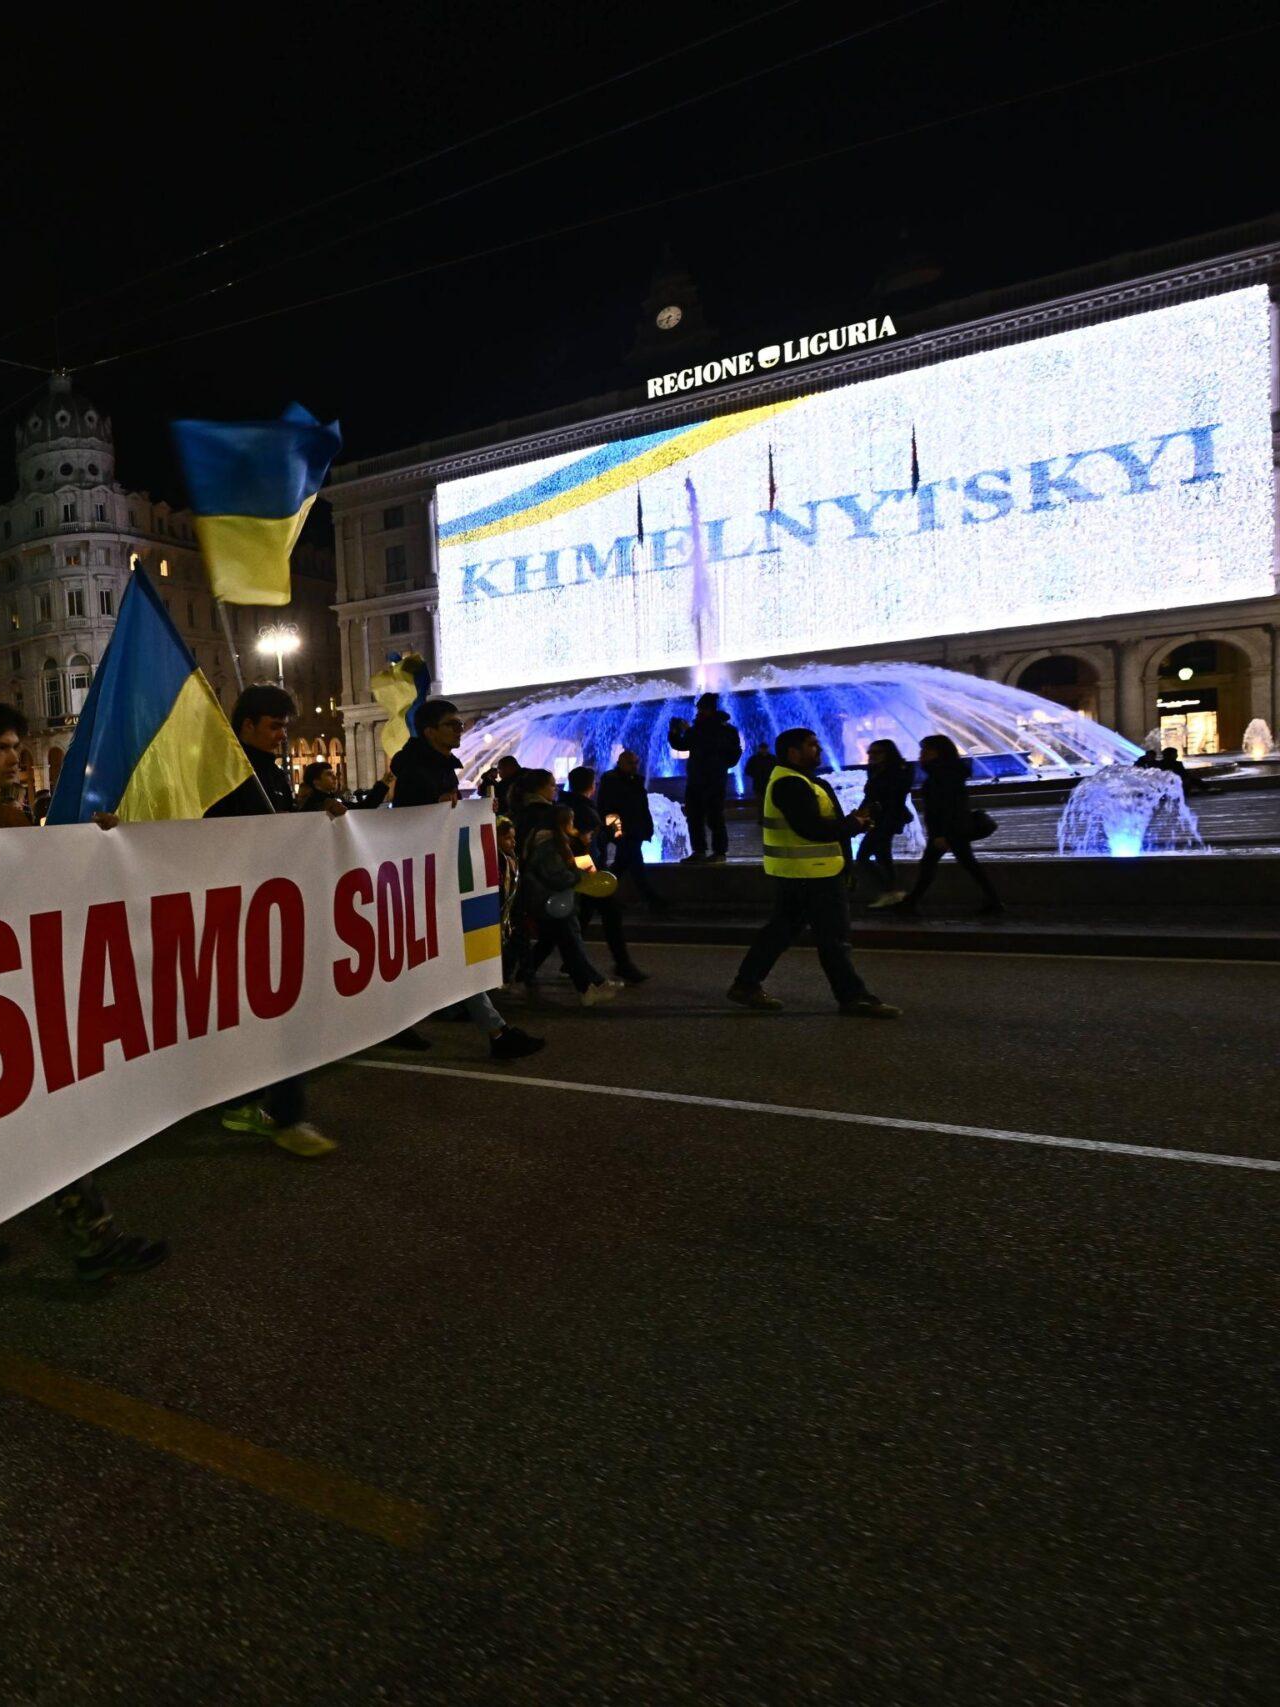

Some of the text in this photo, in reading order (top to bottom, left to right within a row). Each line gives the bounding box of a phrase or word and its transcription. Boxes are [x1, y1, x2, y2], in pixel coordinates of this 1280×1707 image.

[647, 315, 897, 399] REGIONE LIGURIA
[458, 424, 1223, 604] KHMELNYTSKYI
[333, 853, 439, 997] SOLI
